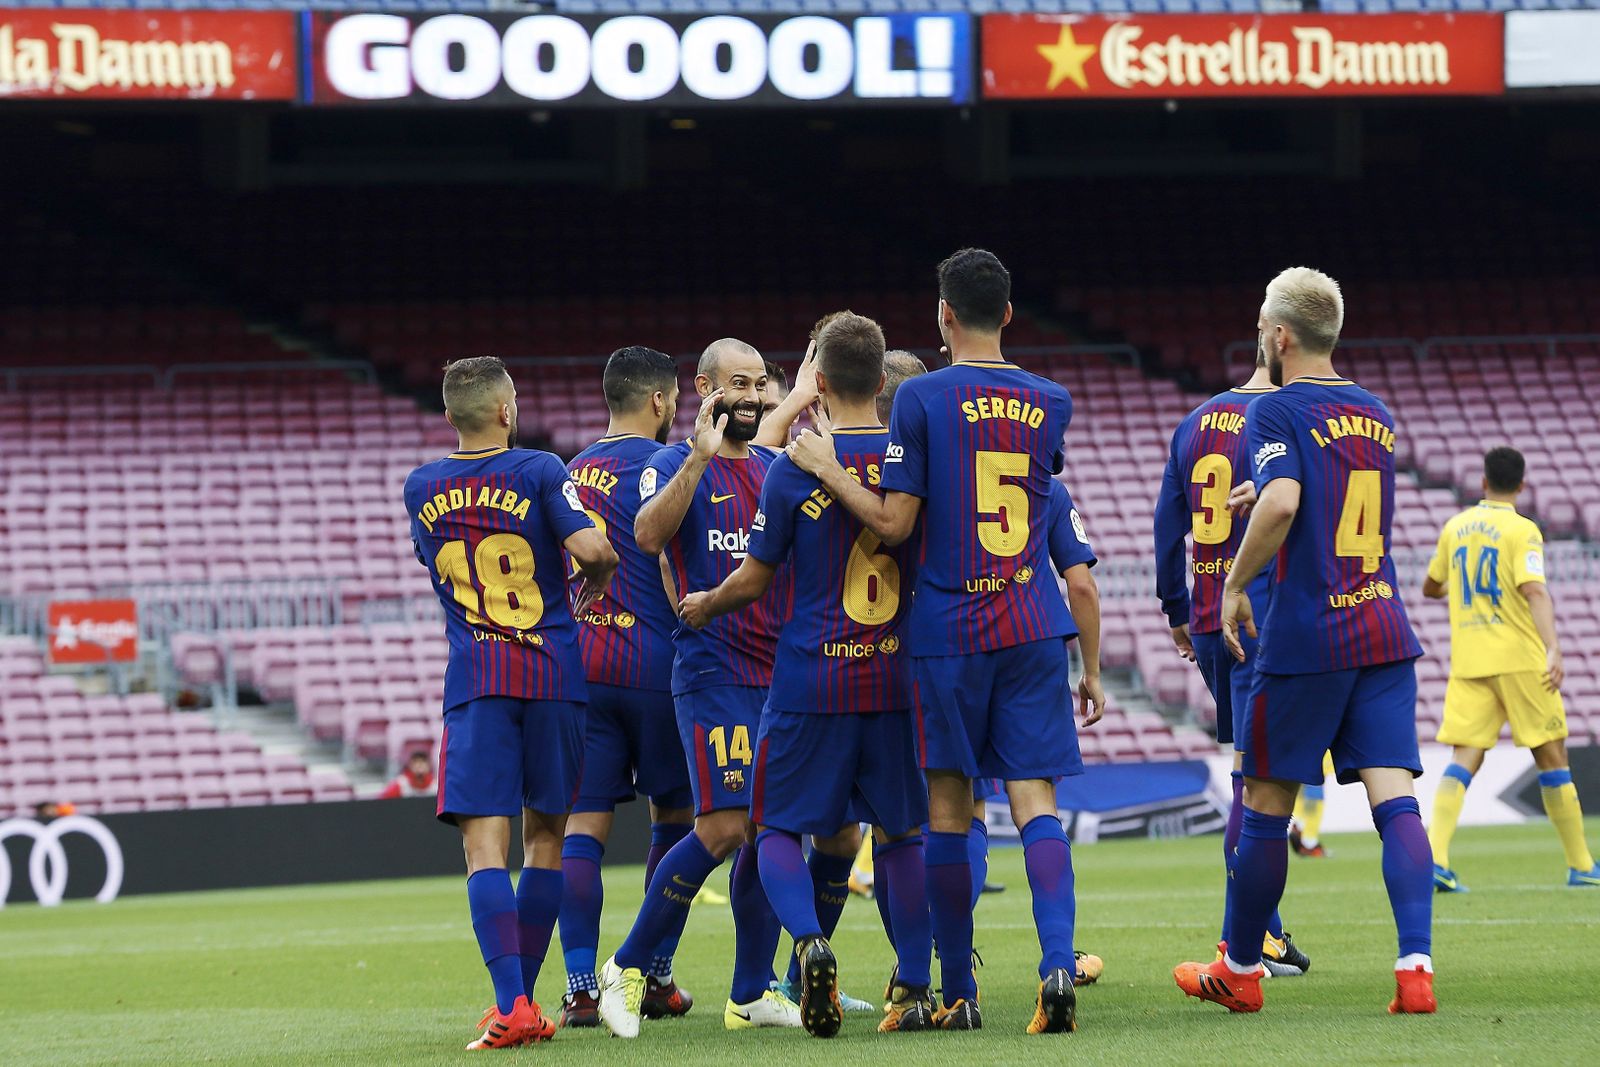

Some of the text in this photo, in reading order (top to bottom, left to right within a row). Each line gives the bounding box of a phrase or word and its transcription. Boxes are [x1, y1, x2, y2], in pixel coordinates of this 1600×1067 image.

[51, 22, 236, 92] Damm
[325, 14, 955, 100] GOOOOOL!
[1100, 22, 1451, 89] Estrella Damm
[961, 396, 1045, 429] SERGIO
[1200, 411, 1246, 435] PIQUE
[418, 486, 531, 533] JORDI ALBA
[976, 450, 1030, 557] 5
[1191, 453, 1233, 545] 3
[1335, 469, 1384, 573] 4
[434, 533, 544, 630] 18
[842, 528, 900, 625] 6
[966, 573, 1008, 592] unic
[1192, 558, 1222, 574] icef
[1329, 582, 1379, 608] unicef
[1453, 545, 1503, 608] 14
[824, 639, 876, 657] unice
[709, 725, 753, 768] 14
